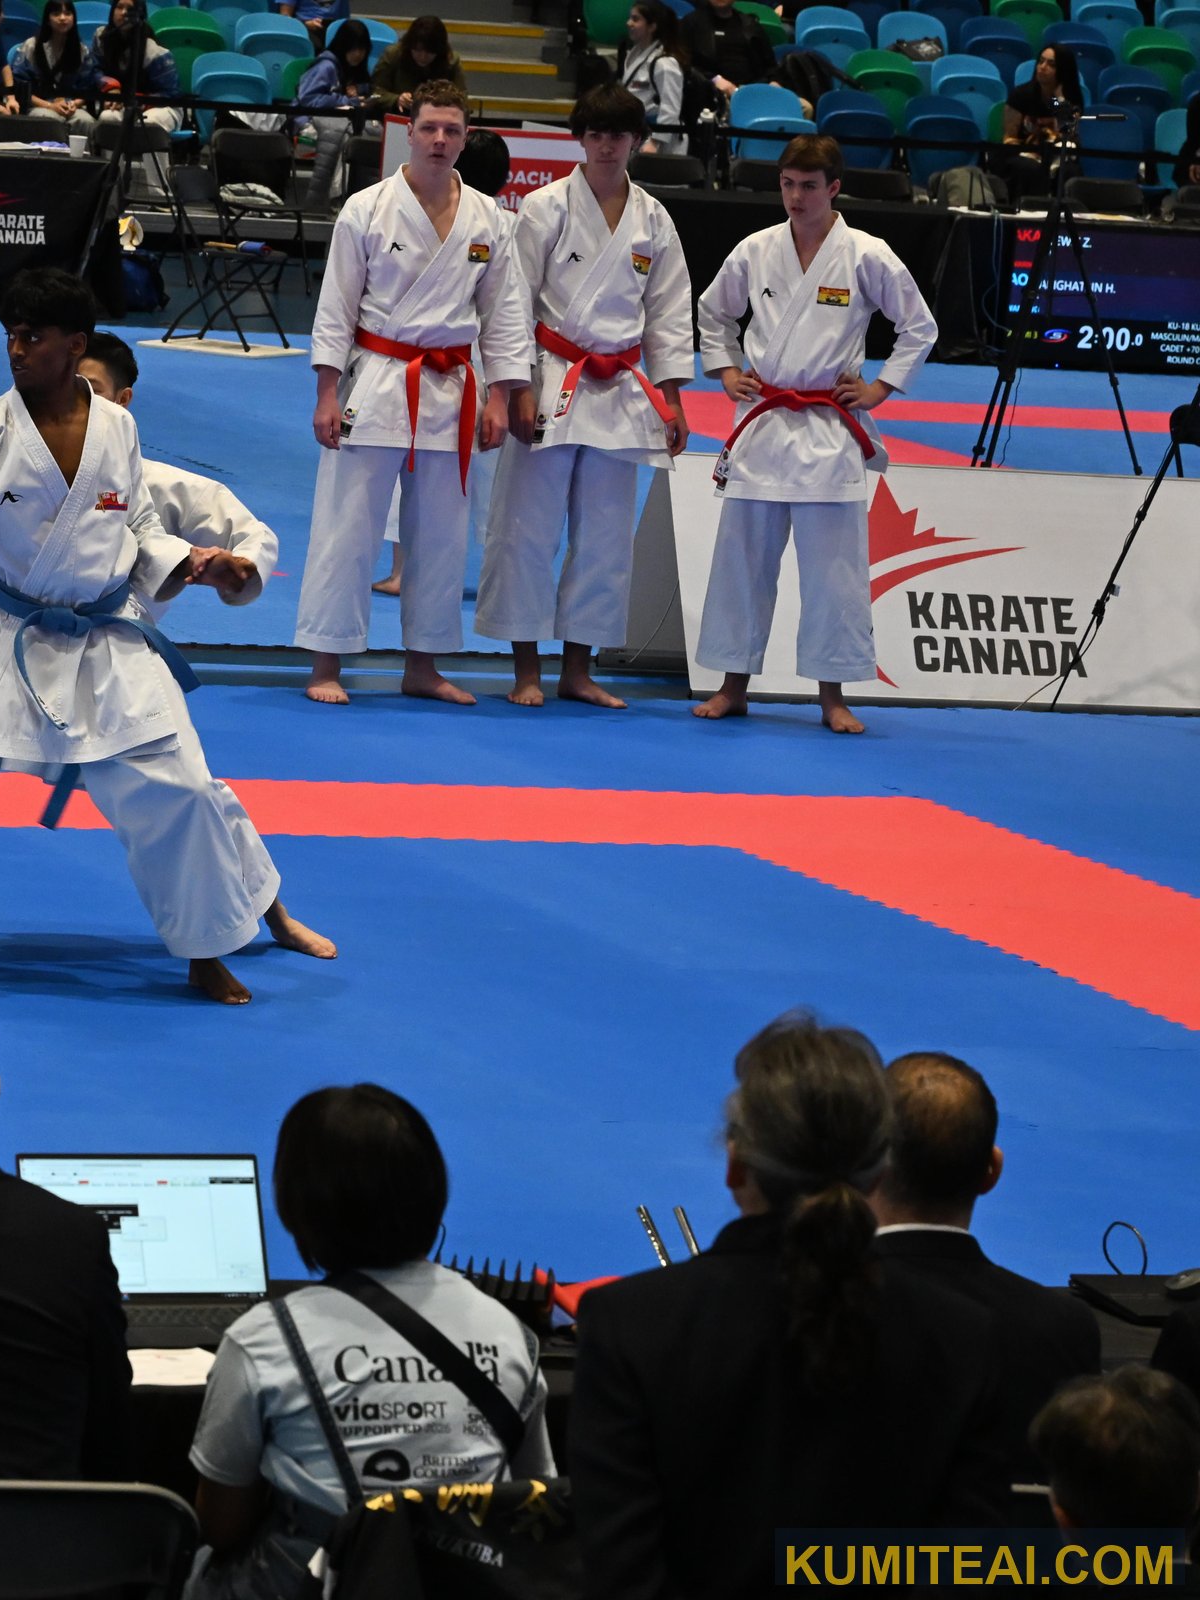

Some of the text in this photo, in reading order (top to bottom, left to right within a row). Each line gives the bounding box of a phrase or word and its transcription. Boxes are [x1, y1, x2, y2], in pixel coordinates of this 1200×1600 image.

[1160, 344, 1185, 353] CADET
[1167, 355, 1195, 365] ROUND
[906, 591, 1078, 635] KARATE
[913, 635, 1088, 678] CANADA
[335, 1397, 447, 1421] viaSPORT
